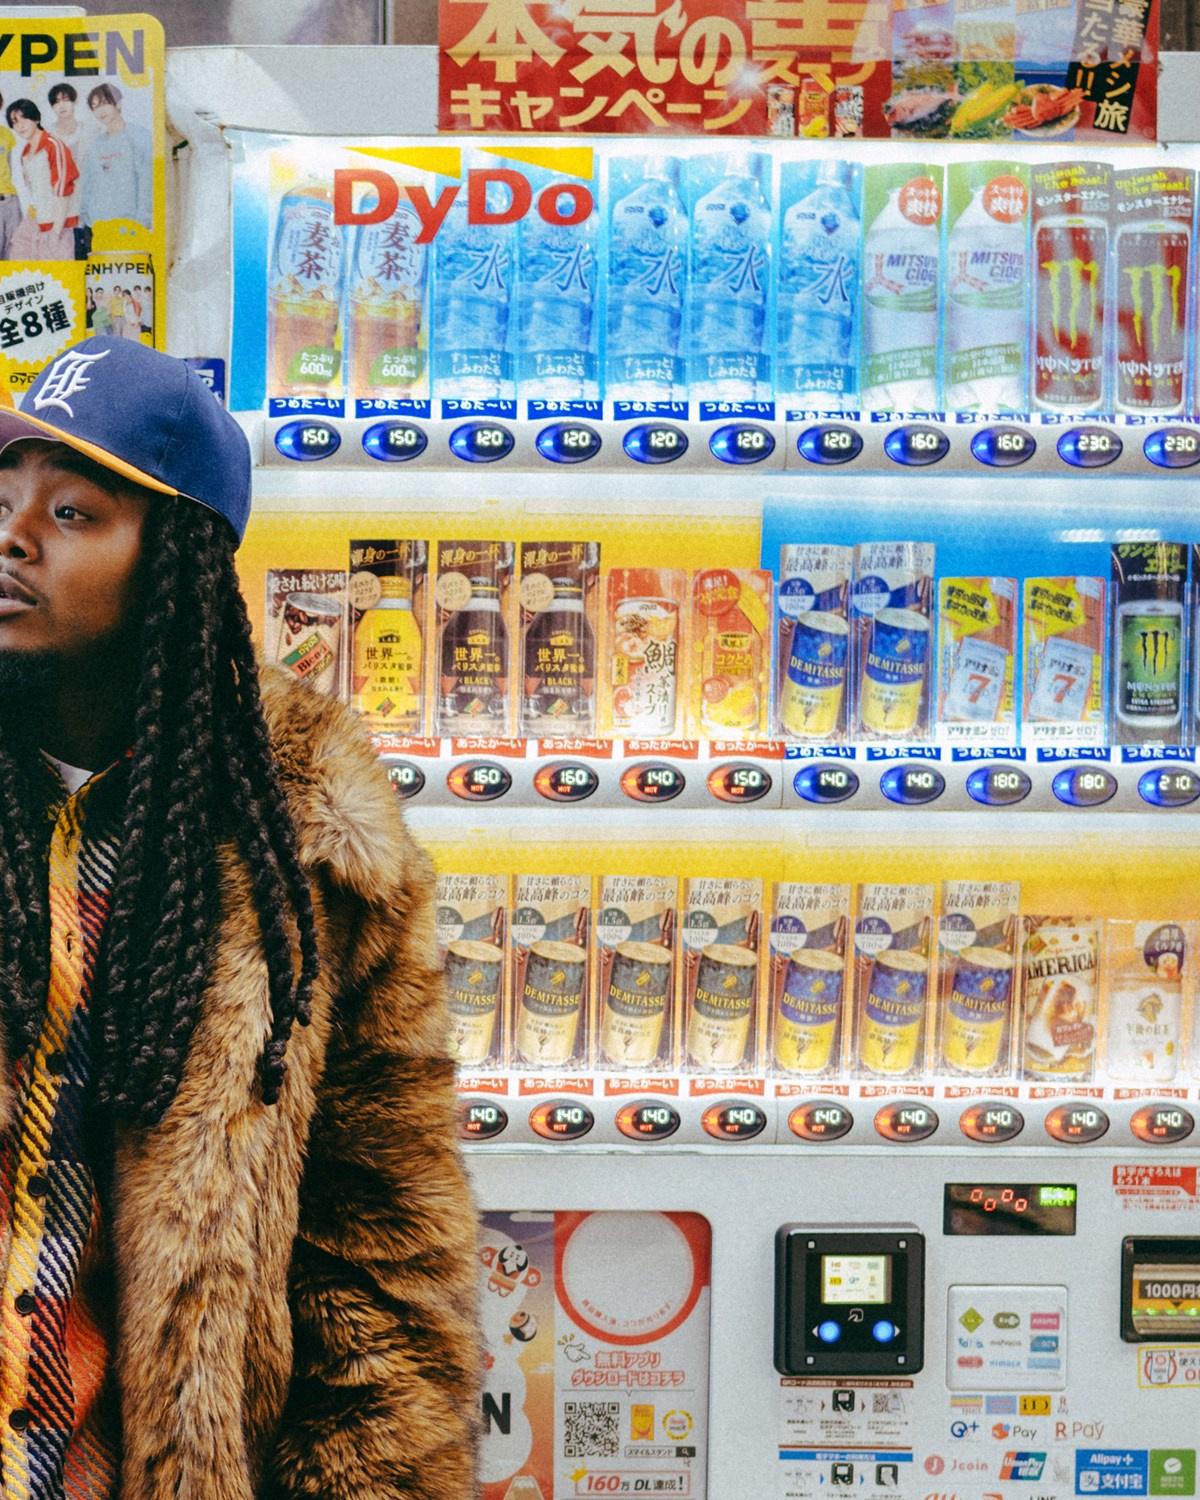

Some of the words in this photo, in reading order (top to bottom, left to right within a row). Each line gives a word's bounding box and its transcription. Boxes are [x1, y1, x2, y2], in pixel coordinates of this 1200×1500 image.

[450, 84, 753, 130] キャンペーン
[333, 169, 593, 244] DyDo
[301, 221, 331, 281] 麦茶
[85, 263, 154, 275] ENHYPEN
[465, 243, 509, 291] 水
[4, 295, 44, 315] デザイン
[300, 352, 334, 364] たっぷり
[452, 365, 501, 376] しみわたる
[390, 430, 415, 445] 150
[738, 432, 763, 448] 120
[1079, 435, 1109, 451] 230
[561, 769, 587, 785] 160
[907, 773, 933, 787] 140
[517, 886, 589, 902] 最高峰のコク
[524, 984, 581, 1007] DEMITASSE
[556, 1109, 582, 1123] 140
[901, 1110, 926, 1125] 140
[1116, 1167, 1182, 1177] 数字がそろえば
[1117, 1177, 1150, 1186] もう1本
[594, 1351, 661, 1370] 無料アプリ
[571, 1370, 686, 1387] ダウンロードはコチラ
[1013, 1425, 1037, 1440] Pay
[1072, 1420, 1105, 1440] Pay
[627, 1447, 674, 1456] スマイルスタンド
[1003, 1457, 1044, 1468] UnionPay
[1101, 1473, 1143, 1489] 支付宝
